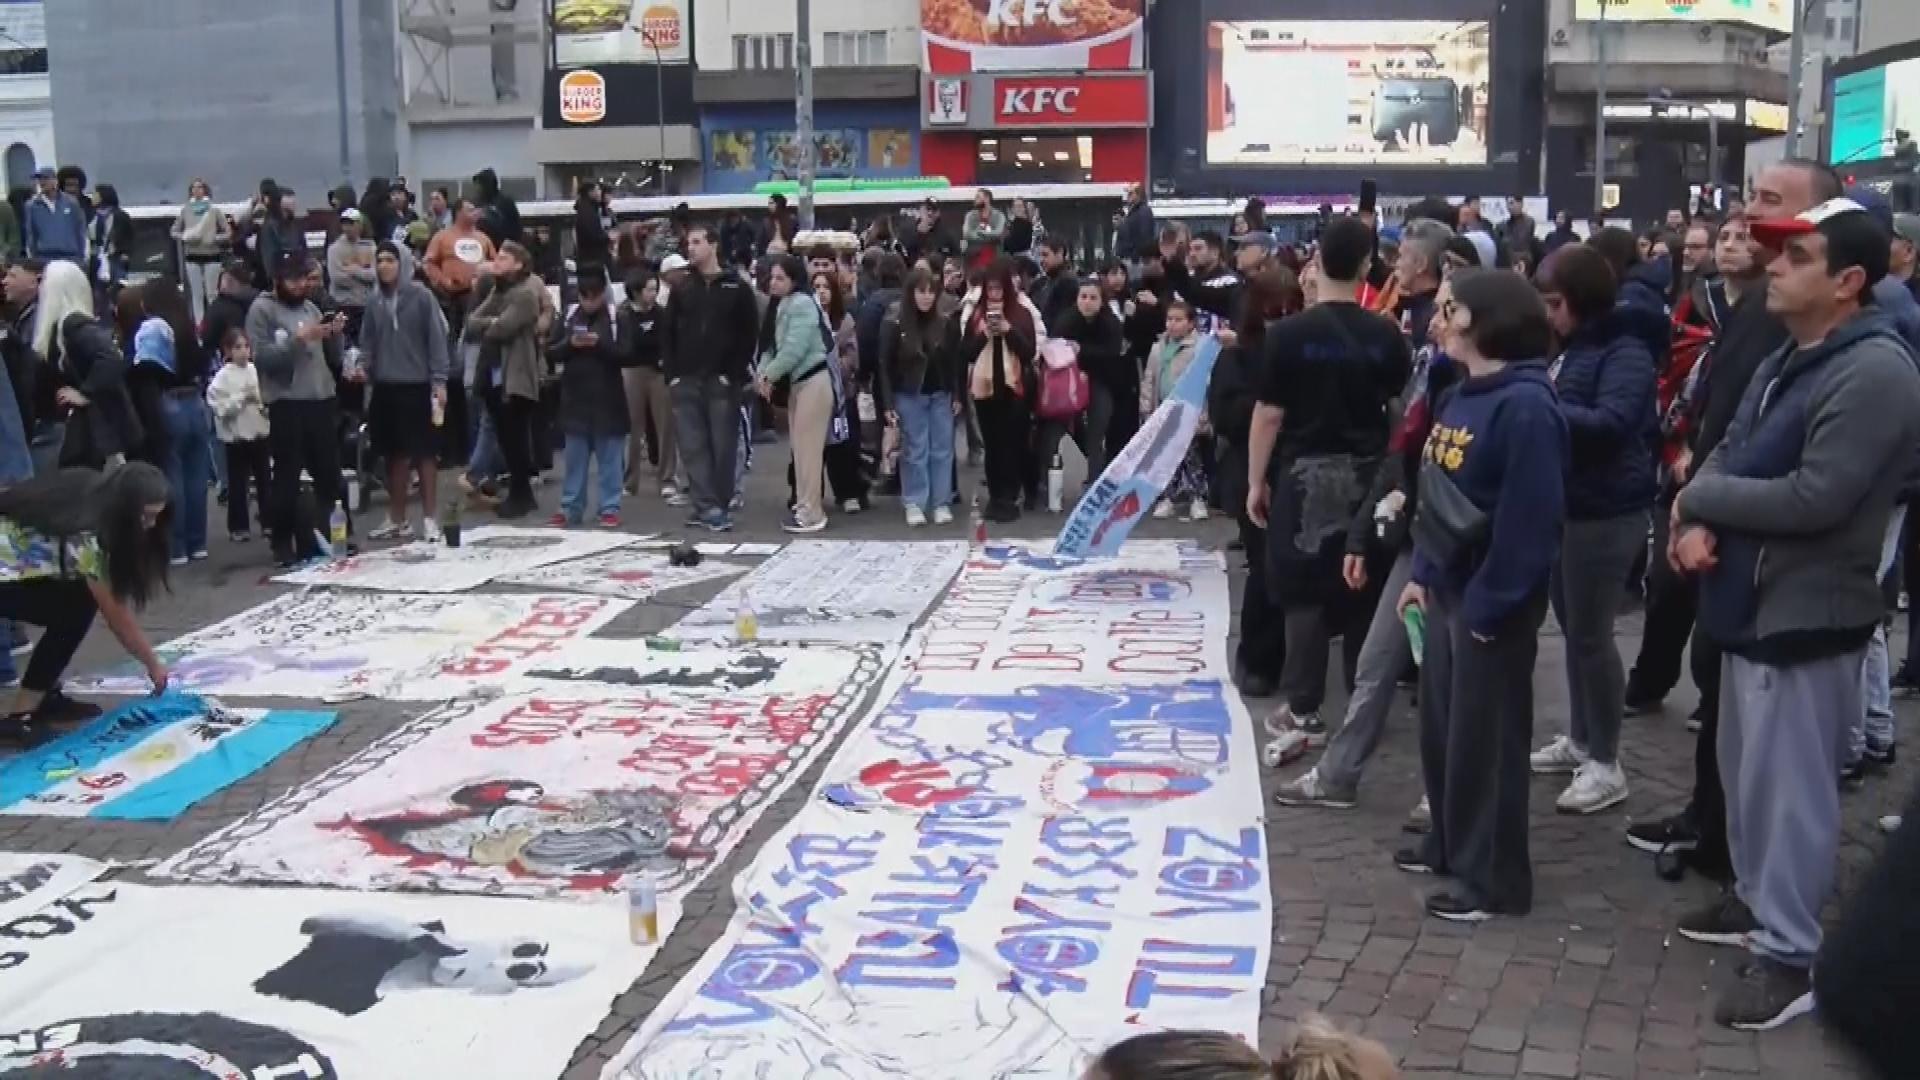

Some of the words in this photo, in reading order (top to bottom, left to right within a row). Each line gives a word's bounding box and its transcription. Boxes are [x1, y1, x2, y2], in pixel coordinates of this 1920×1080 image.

[642, 29, 680, 41] KING
[988, 0, 1077, 27] KFC
[563, 98, 602, 110] KING
[1001, 87, 1080, 113] KFC
[1033, 815, 1139, 878] SER
[1150, 826, 1261, 919] VOZ
[833, 926, 960, 990] TU
[1125, 938, 1256, 1009] TU
